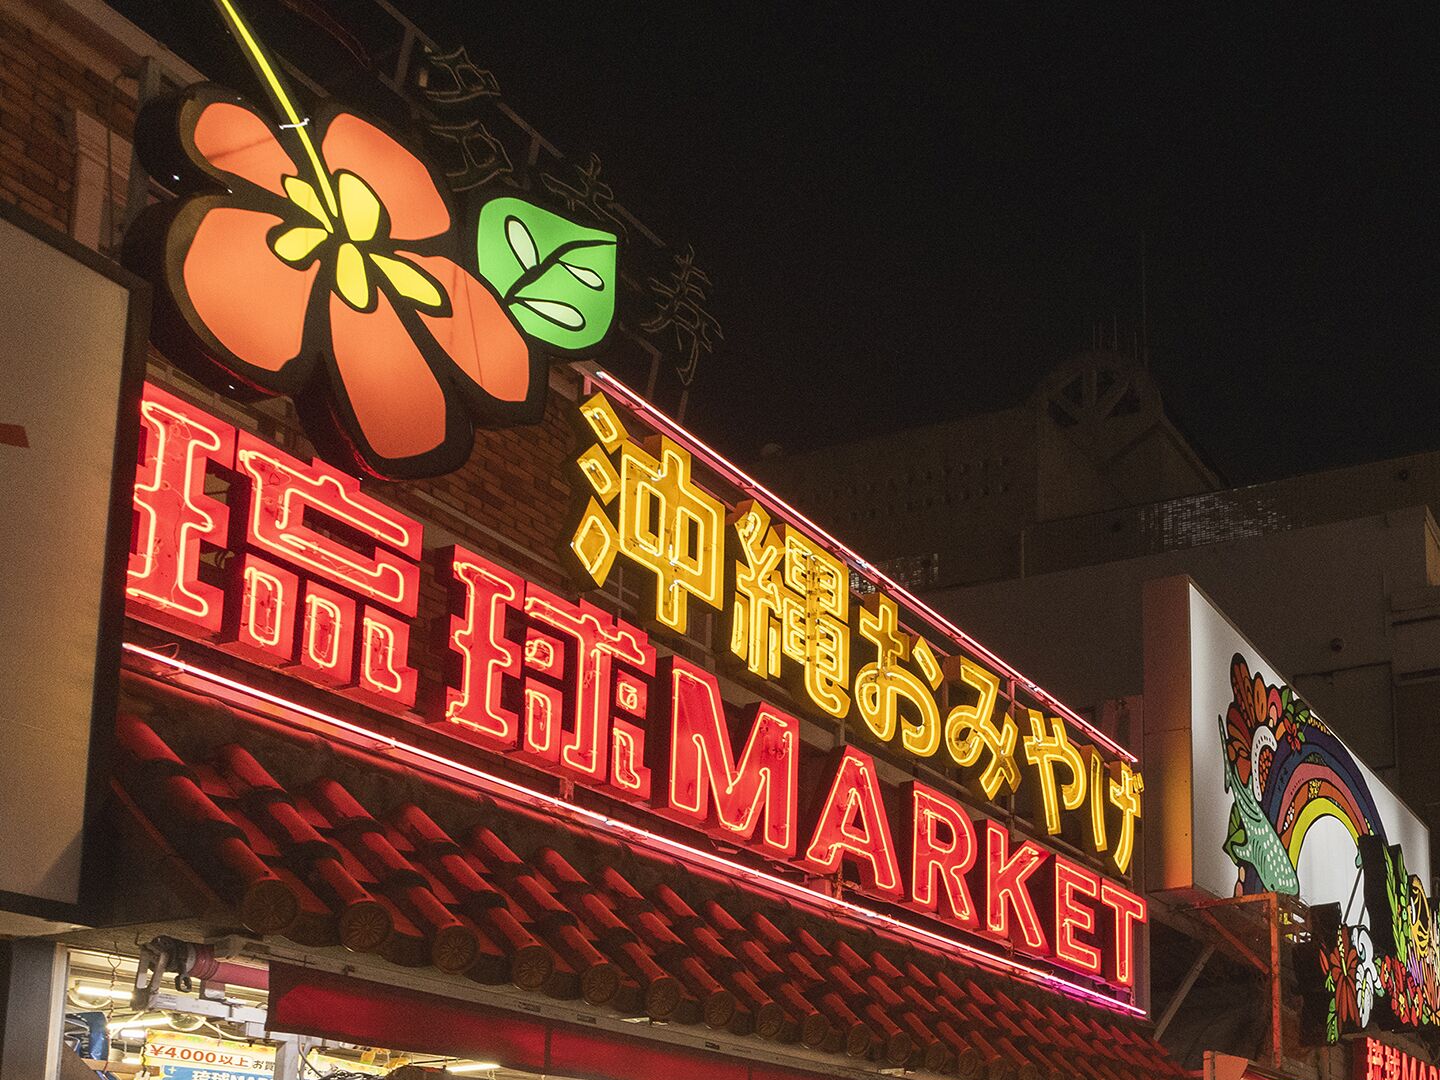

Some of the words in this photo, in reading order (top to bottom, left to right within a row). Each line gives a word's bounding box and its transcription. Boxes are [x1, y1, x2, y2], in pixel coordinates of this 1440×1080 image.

[570, 392, 1145, 876] 沖縄おみやげ
